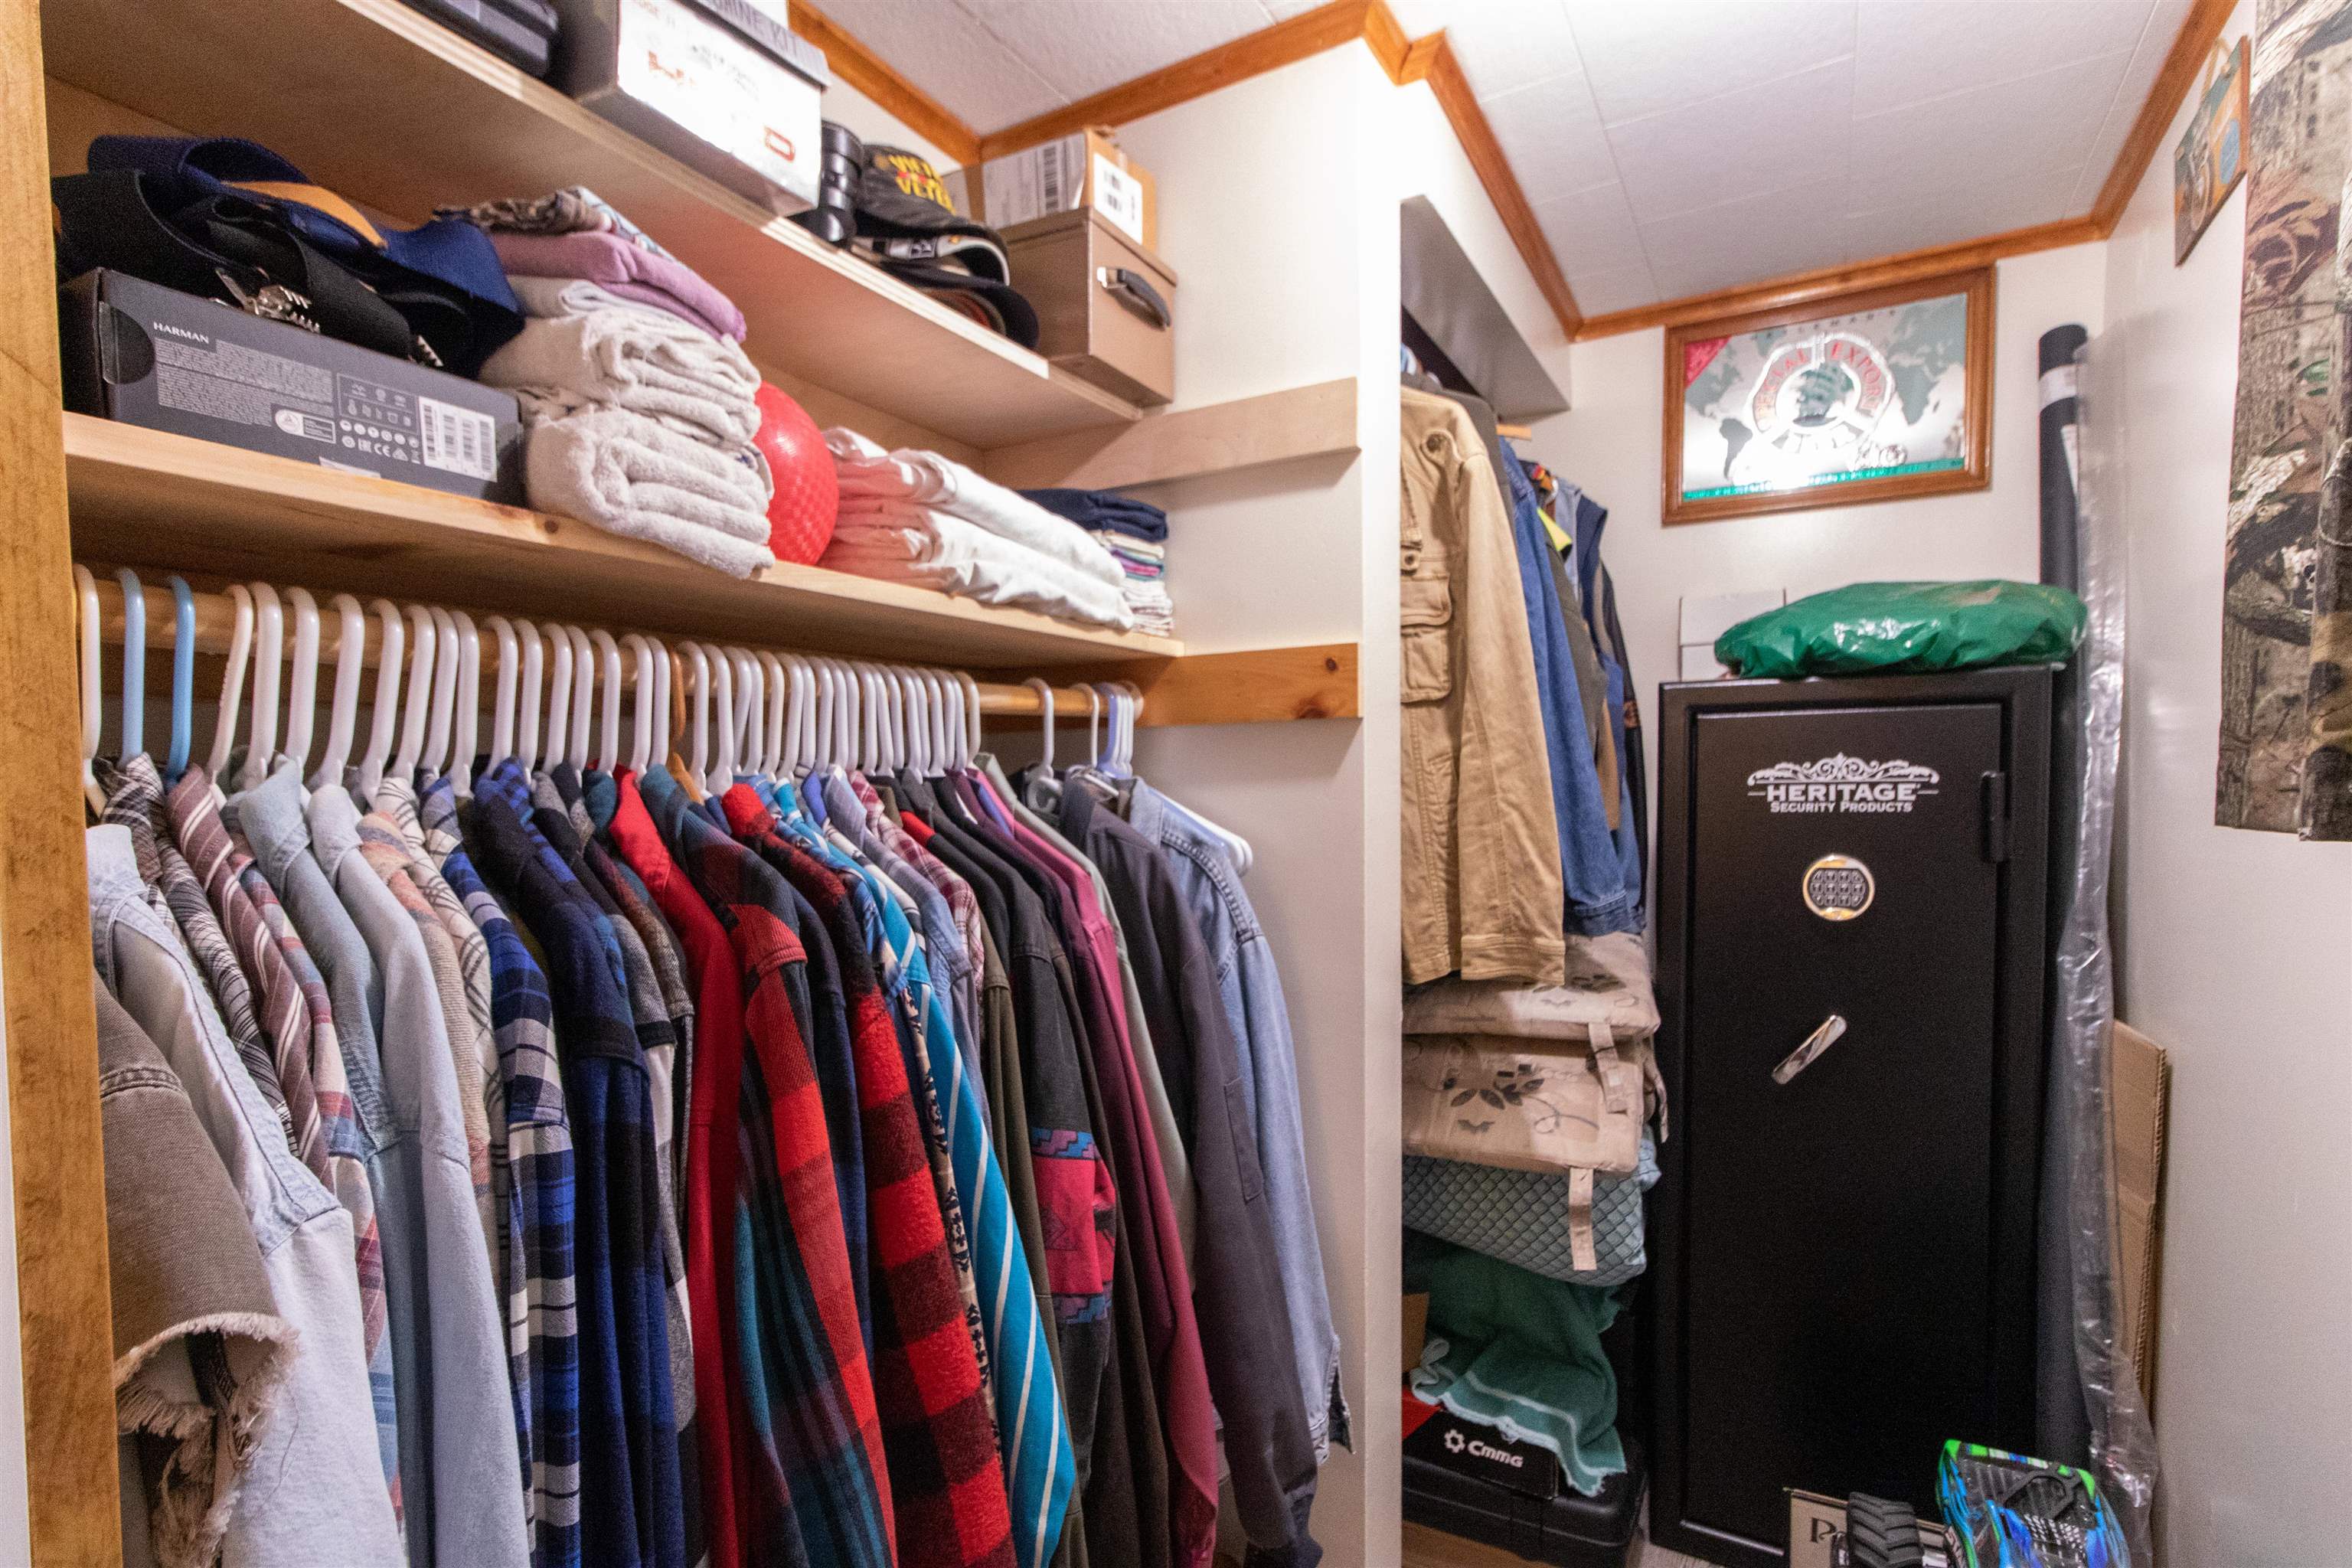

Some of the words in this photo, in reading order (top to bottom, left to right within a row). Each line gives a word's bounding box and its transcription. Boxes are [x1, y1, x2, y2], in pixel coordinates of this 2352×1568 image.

[153, 321, 209, 344] HARMAN
[1831, 342, 1882, 410] EXPORT
[1766, 783, 1917, 802] HERITAGE
[1770, 801, 1836, 813] SECURITY
[1840, 802, 1913, 813] PRODUCTS
